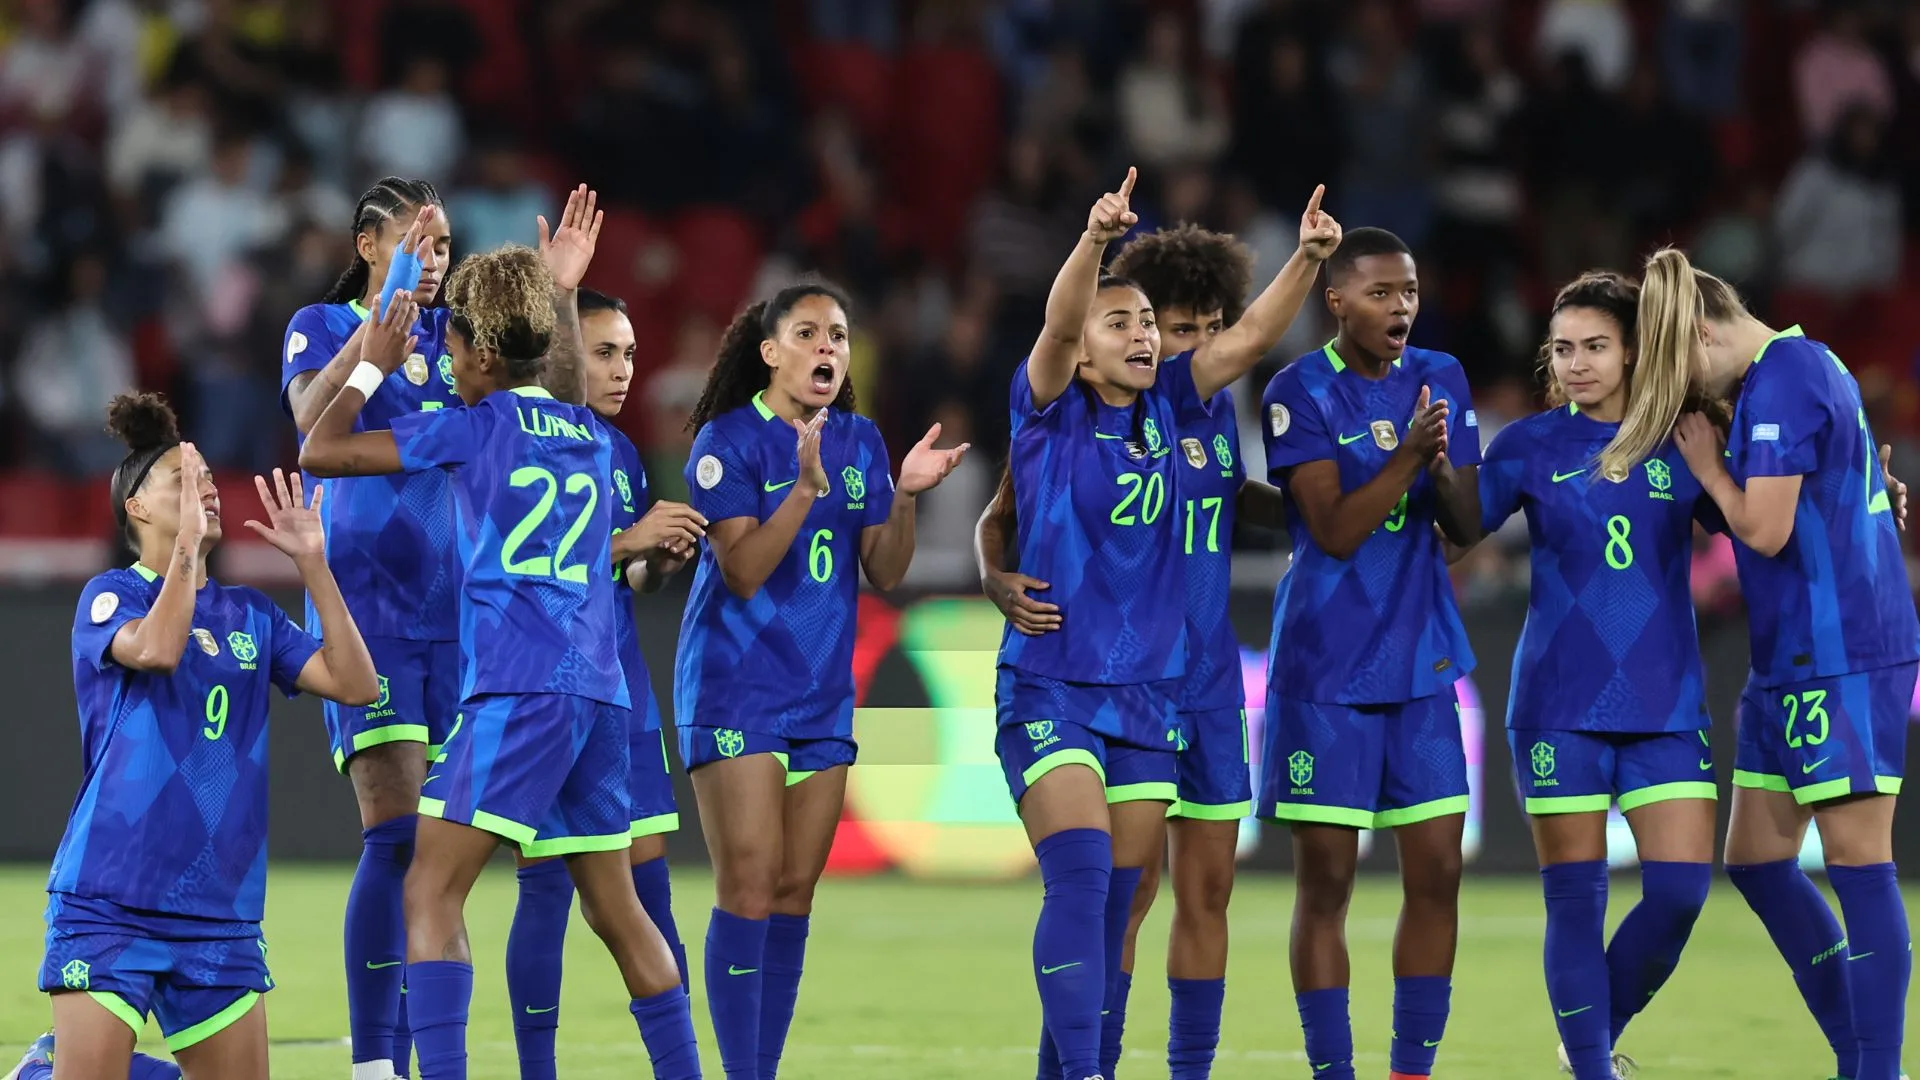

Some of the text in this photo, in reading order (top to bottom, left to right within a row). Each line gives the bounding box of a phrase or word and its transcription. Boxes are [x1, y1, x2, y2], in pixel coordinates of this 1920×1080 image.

[501, 466, 598, 584] 22
[1111, 472, 1164, 525] 20
[1185, 497, 1222, 554] 17
[809, 528, 833, 583] 6
[1604, 515, 1634, 570] 8
[203, 685, 229, 740] 9
[365, 708, 396, 720] BRASIL
[1783, 689, 1829, 748] 23
